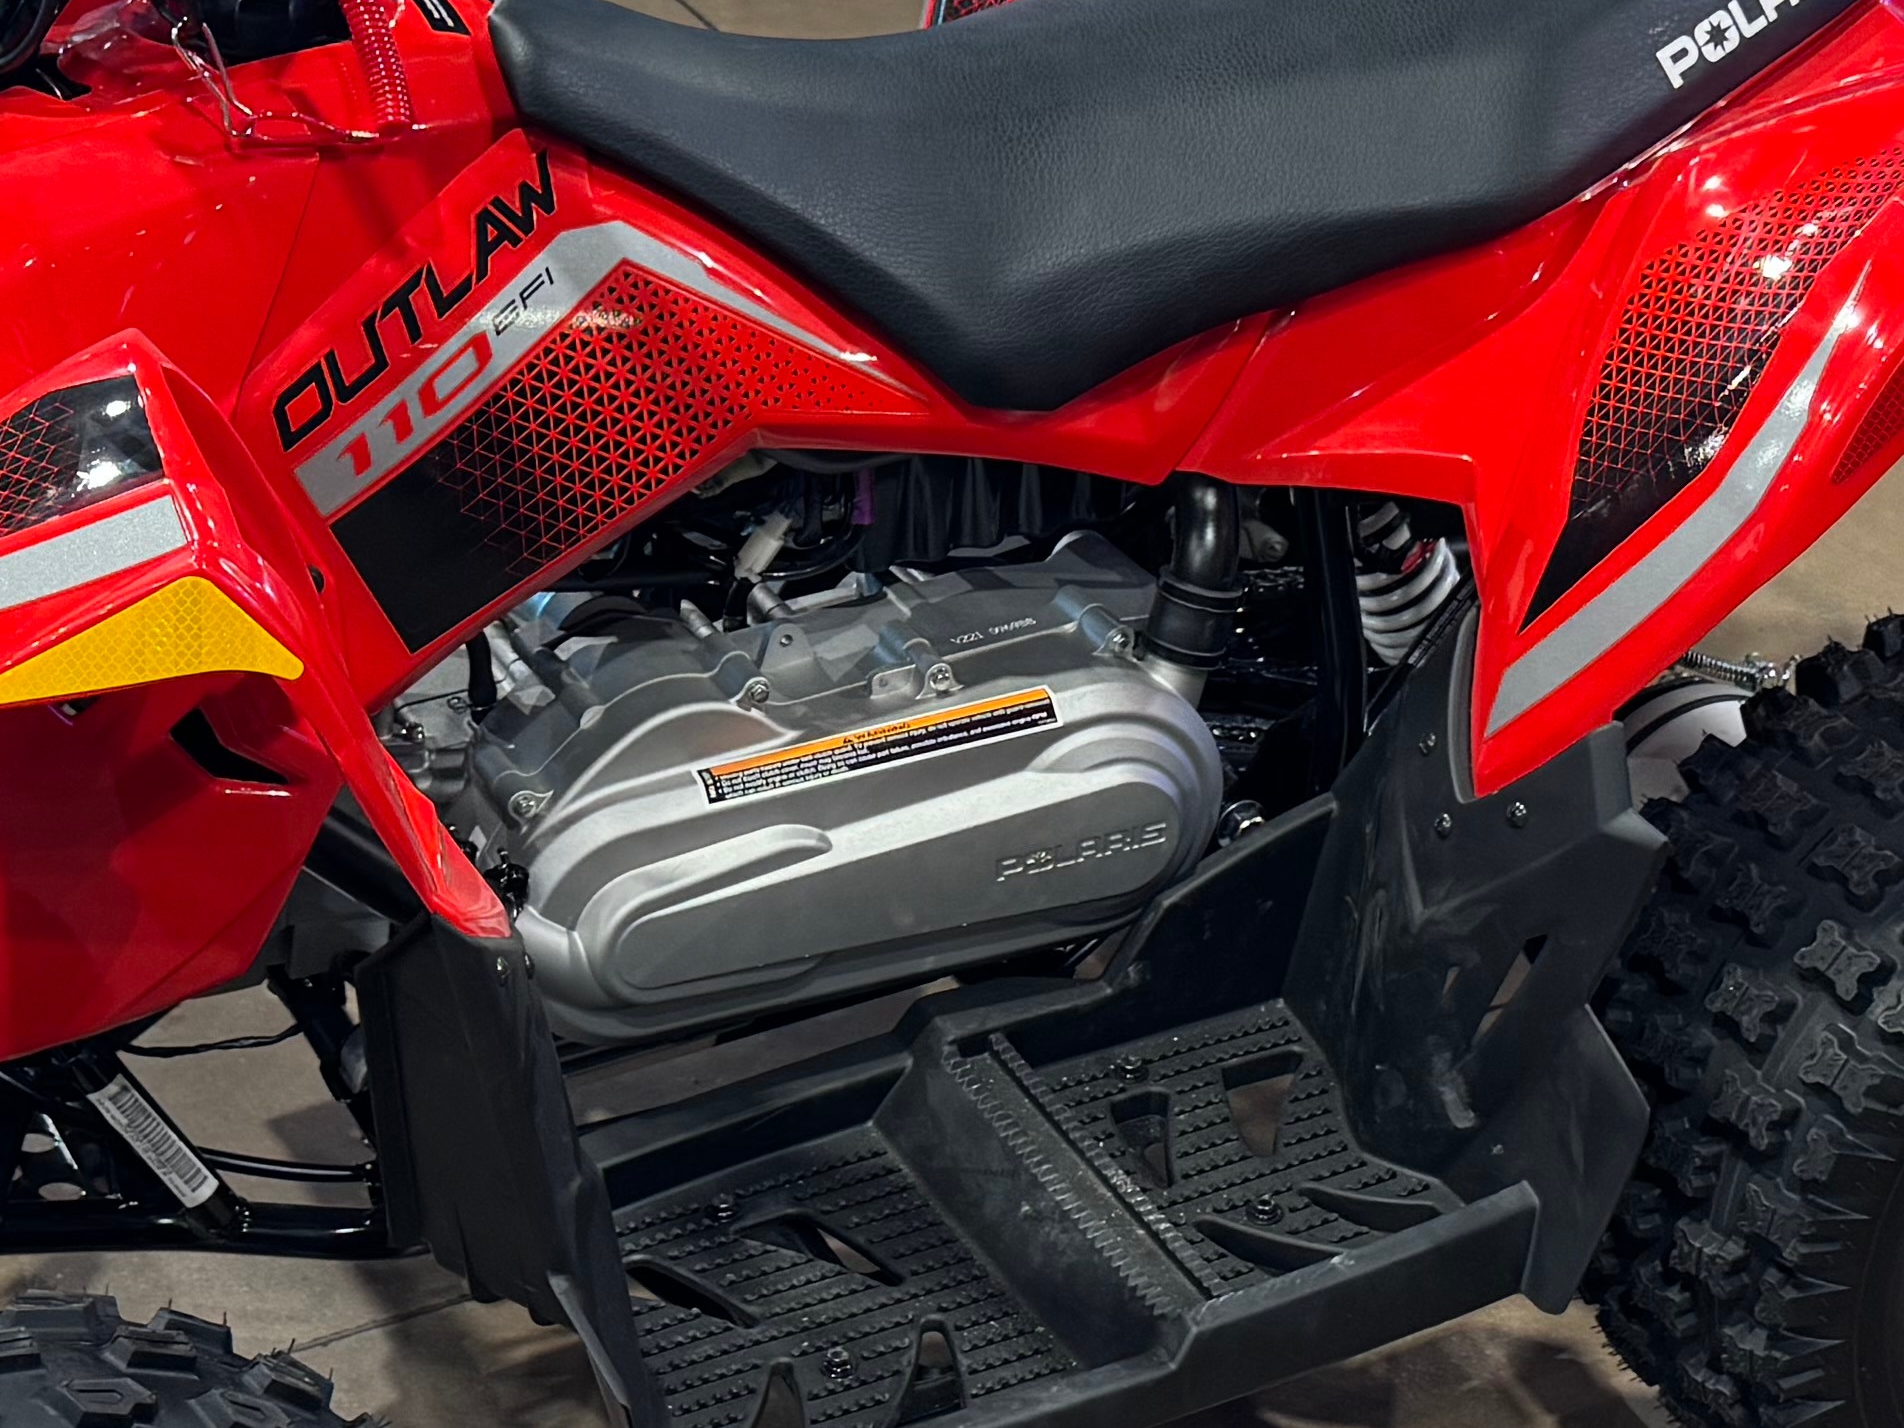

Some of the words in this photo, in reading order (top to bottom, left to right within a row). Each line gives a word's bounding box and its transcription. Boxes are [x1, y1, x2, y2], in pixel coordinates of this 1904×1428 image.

[273, 149, 556, 452] OUTLAW
[336, 329, 493, 477] 110
[493, 267, 554, 337] EFI
[996, 822, 1168, 883] POLARIS
